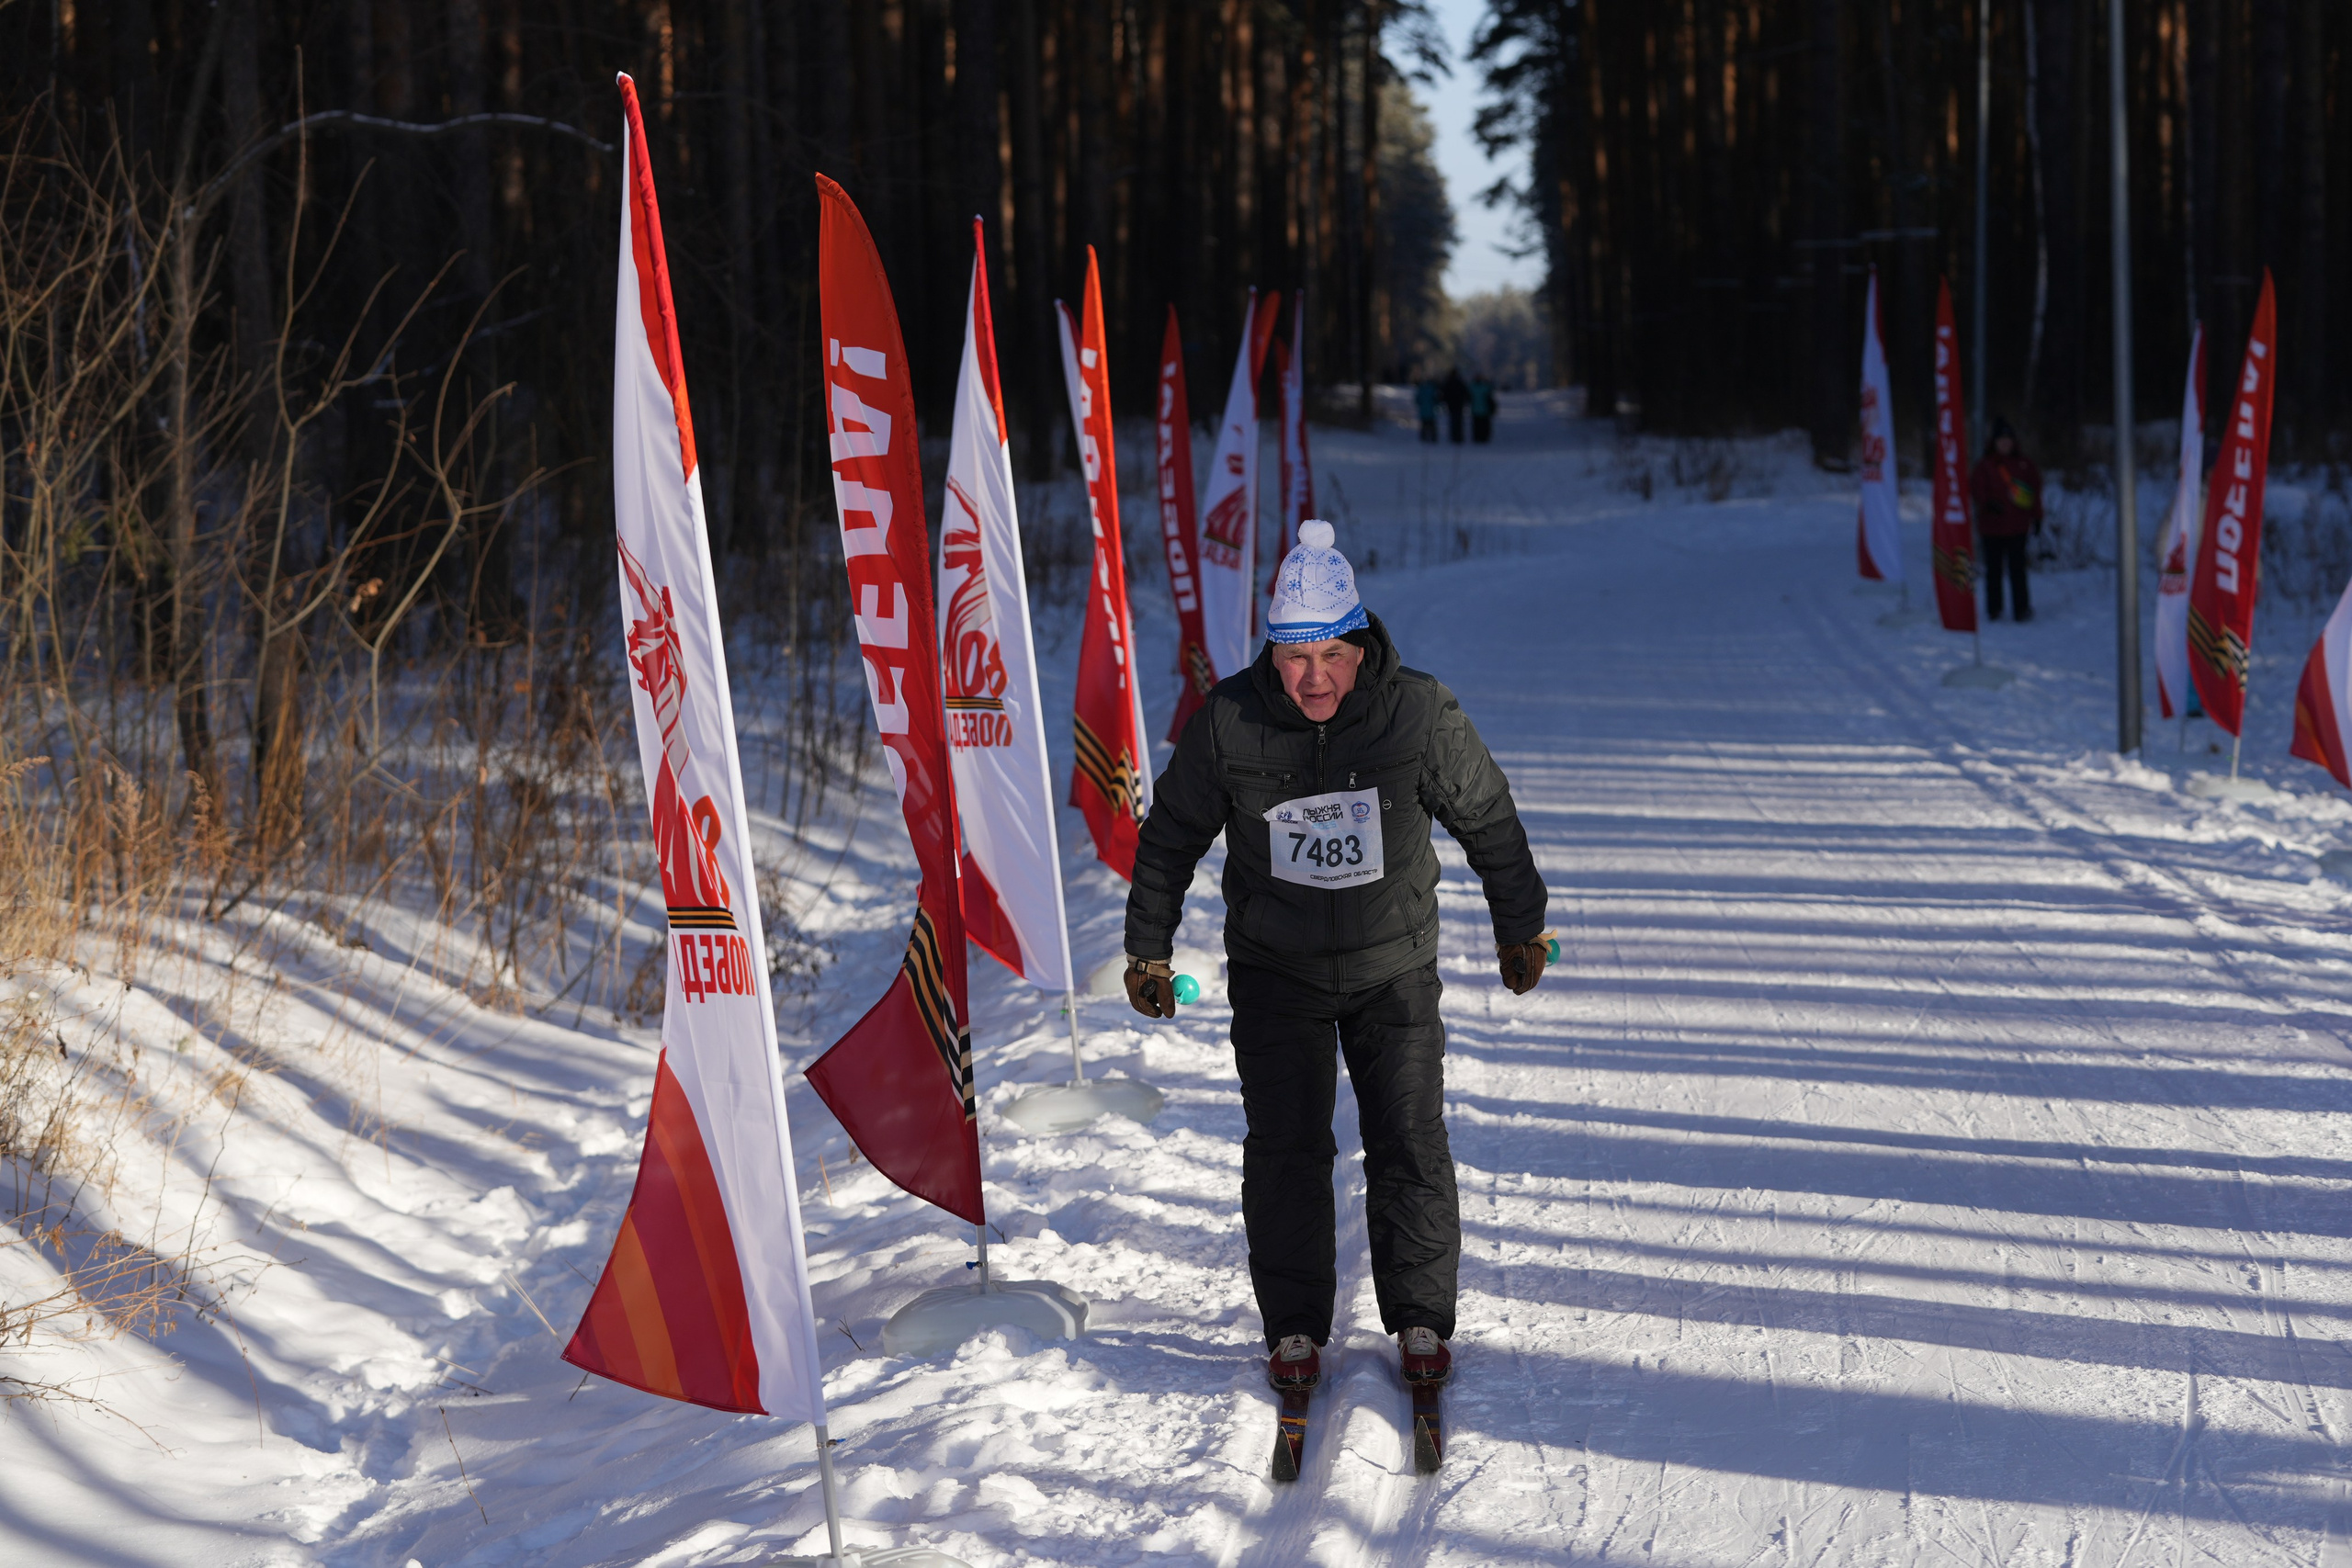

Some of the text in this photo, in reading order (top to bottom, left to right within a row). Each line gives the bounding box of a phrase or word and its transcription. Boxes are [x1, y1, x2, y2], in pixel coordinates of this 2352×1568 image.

[1303, 804, 1341, 816] ЛЫЖНЯ
[1312, 820, 1337, 829] 2025
[1288, 831, 1363, 868] 7483
[1310, 868, 1378, 882] СВЕРДЛОВСКАЯ ОБЛАСТЬ
